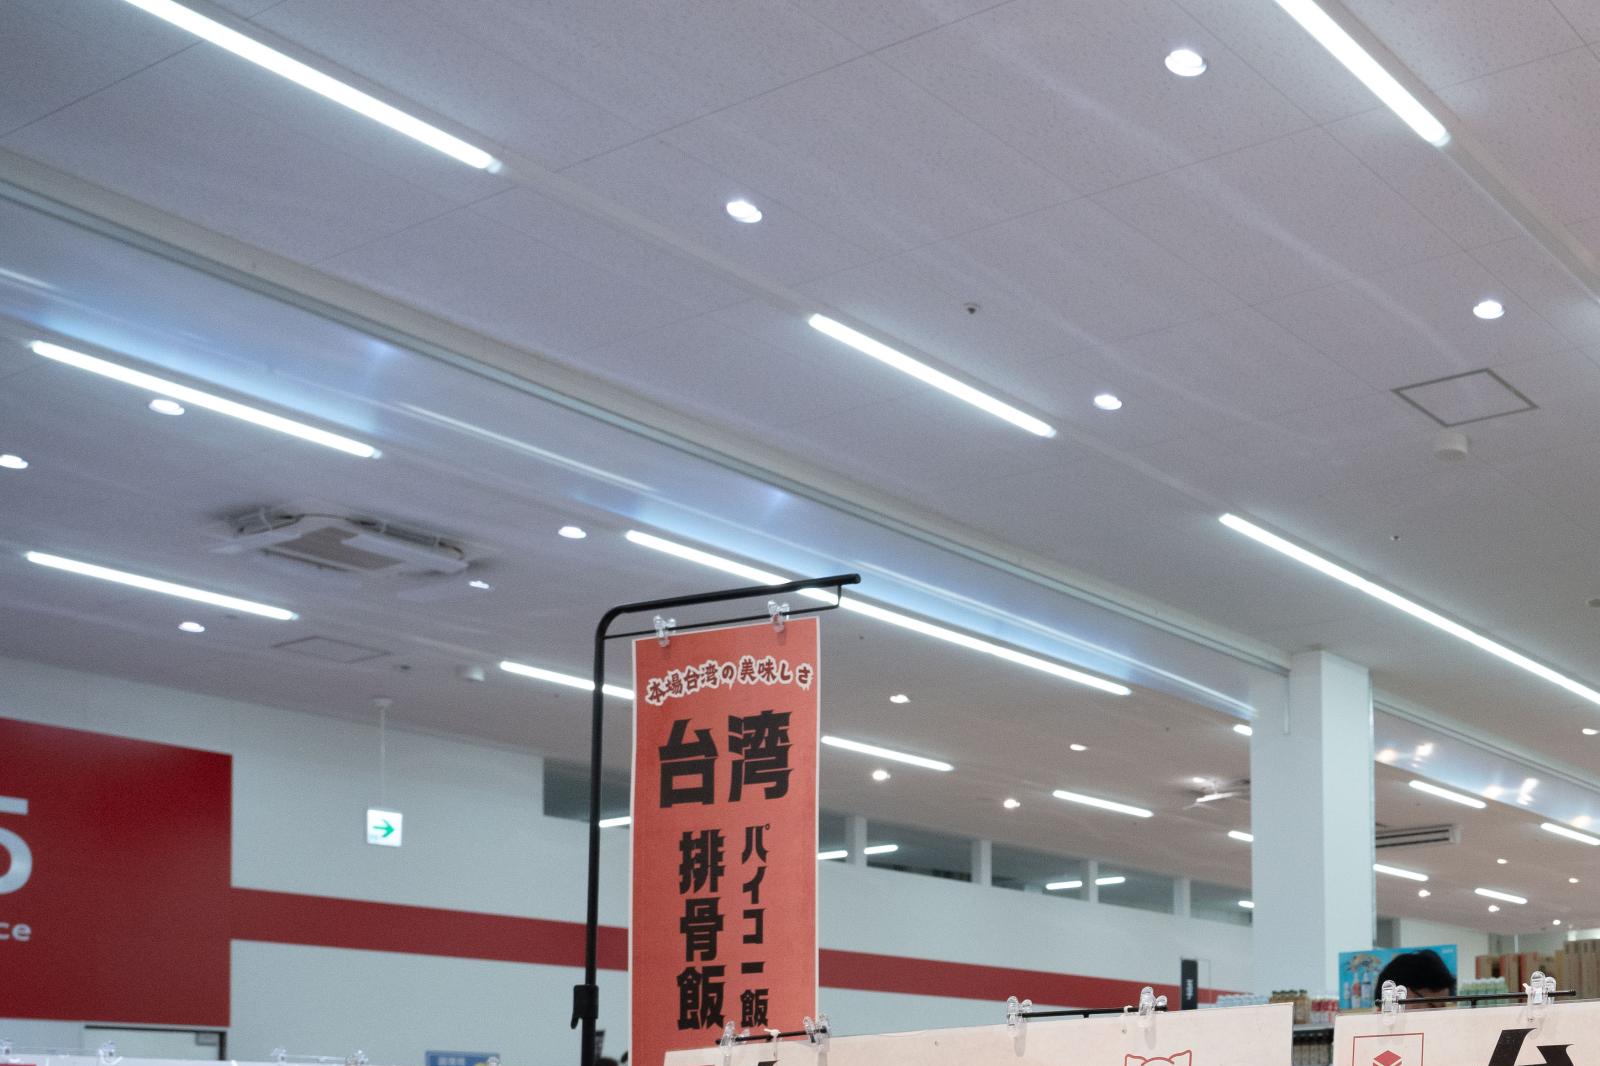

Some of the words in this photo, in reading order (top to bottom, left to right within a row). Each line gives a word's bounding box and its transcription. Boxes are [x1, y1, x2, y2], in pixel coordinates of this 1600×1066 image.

[648, 657, 812, 703] 本場台湾の美味しさ
[658, 709, 795, 809] 台湾
[676, 828, 728, 1031] 排骨飯
[740, 823, 771, 1028] パイコー飯
